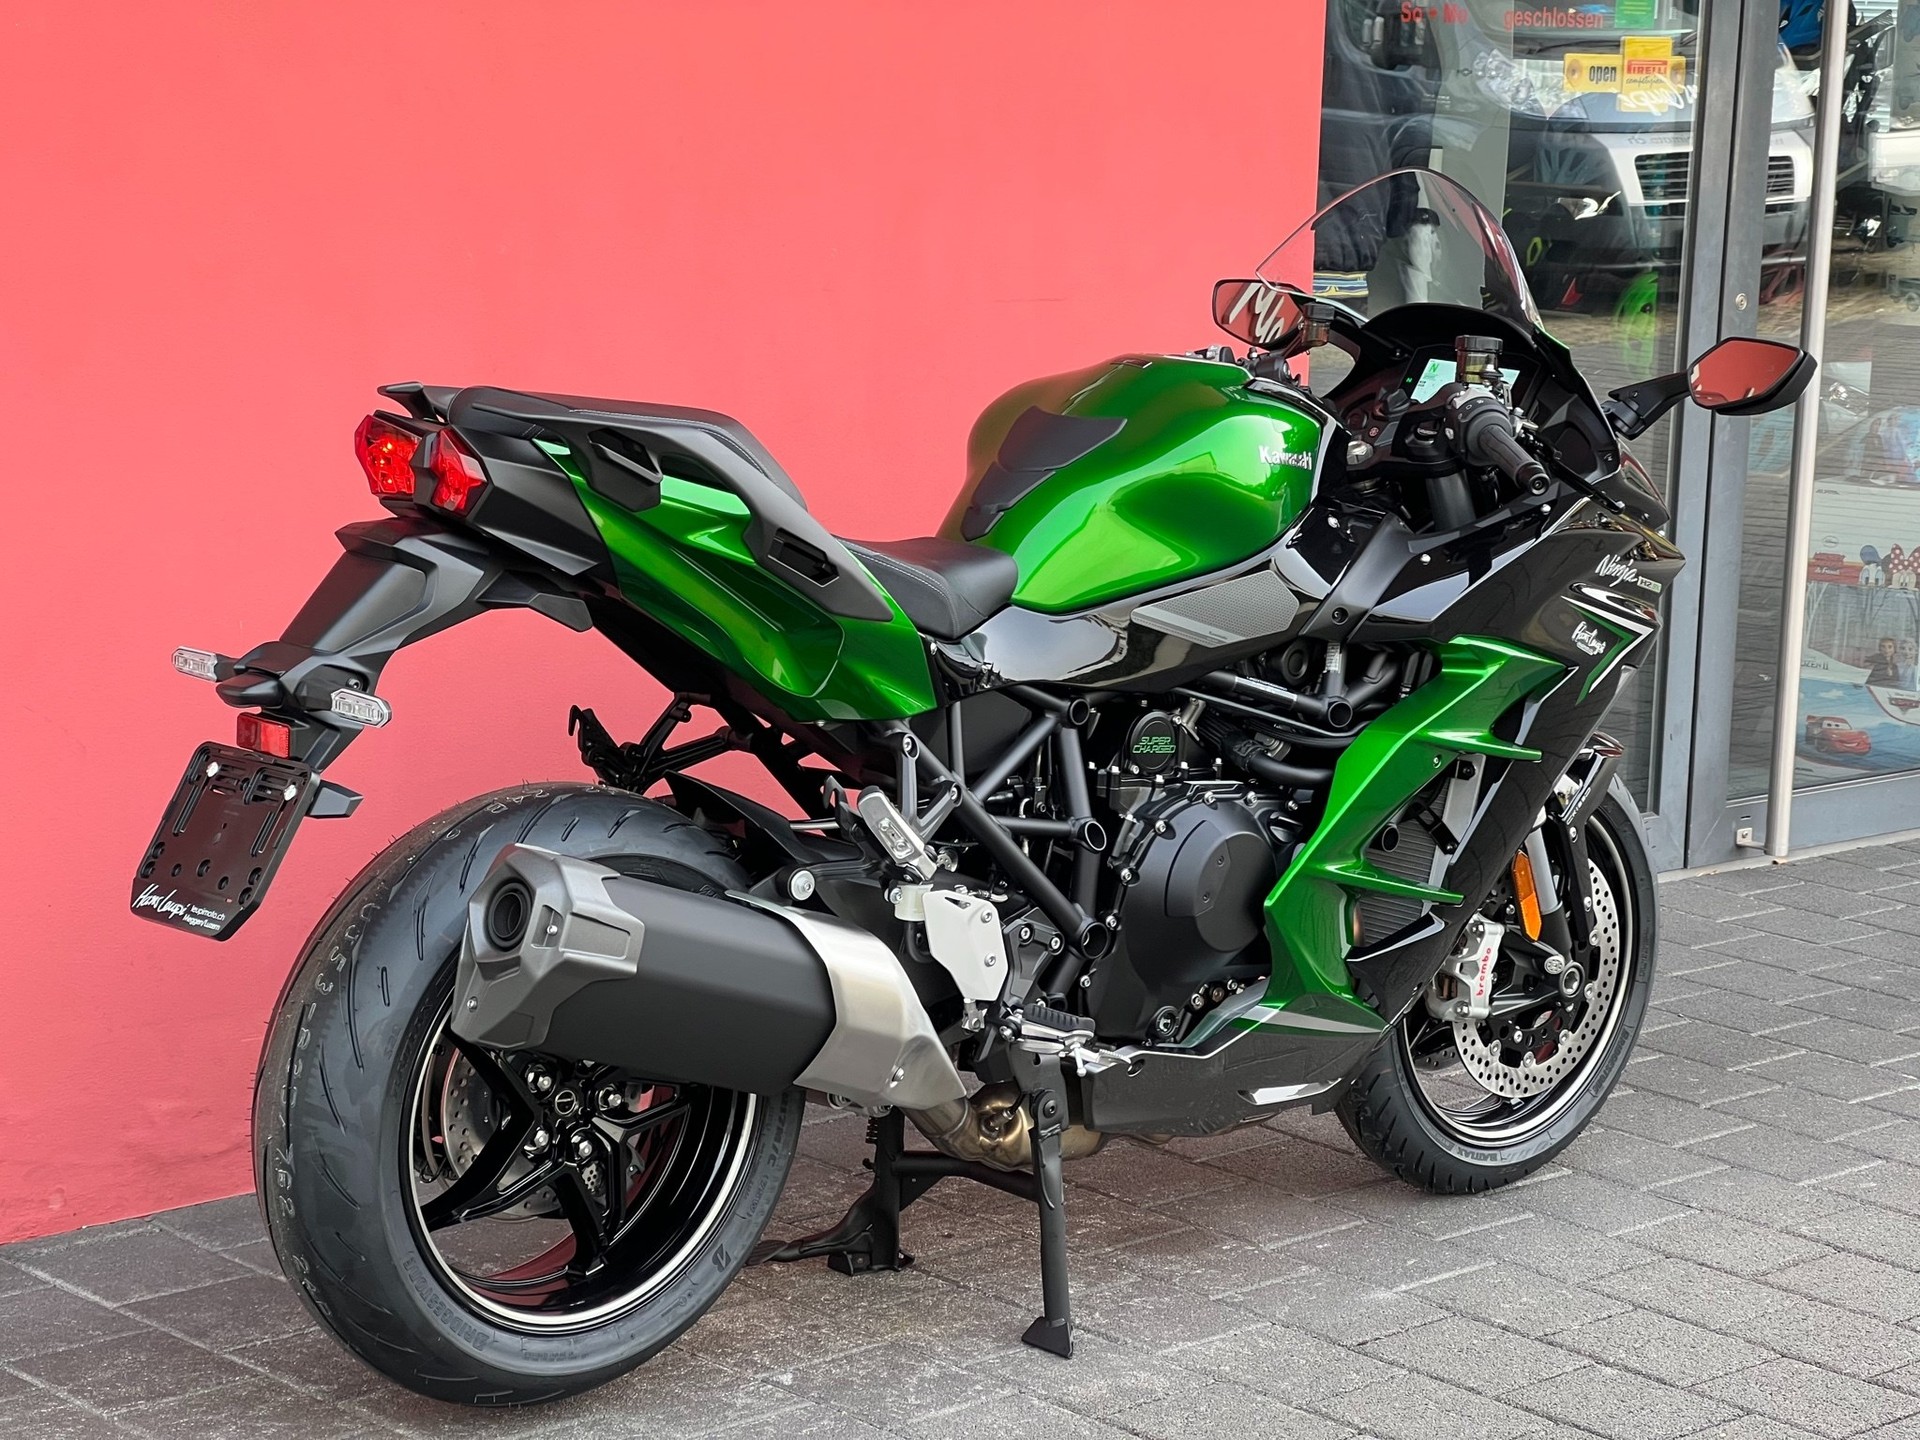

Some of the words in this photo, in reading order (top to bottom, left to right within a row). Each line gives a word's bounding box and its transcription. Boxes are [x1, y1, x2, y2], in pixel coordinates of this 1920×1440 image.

[1504, 7, 1603, 30] geschlossen
[1589, 65, 1617, 84] open
[1626, 59, 1668, 74] PIRELLI
[1430, 363, 1439, 373] N
[1258, 445, 1312, 470] Kawasaki
[1595, 554, 1638, 587] Ninja
[1132, 745, 1176, 754] CHARGED
[1139, 736, 1171, 745] SUPER
[131, 883, 164, 909] Hans
[157, 889, 191, 919] Leupi
[191, 905, 226, 921] leupimoto.ch
[1476, 947, 1491, 996] brembo
[403, 1257, 489, 1351] BRIDGESTONE
